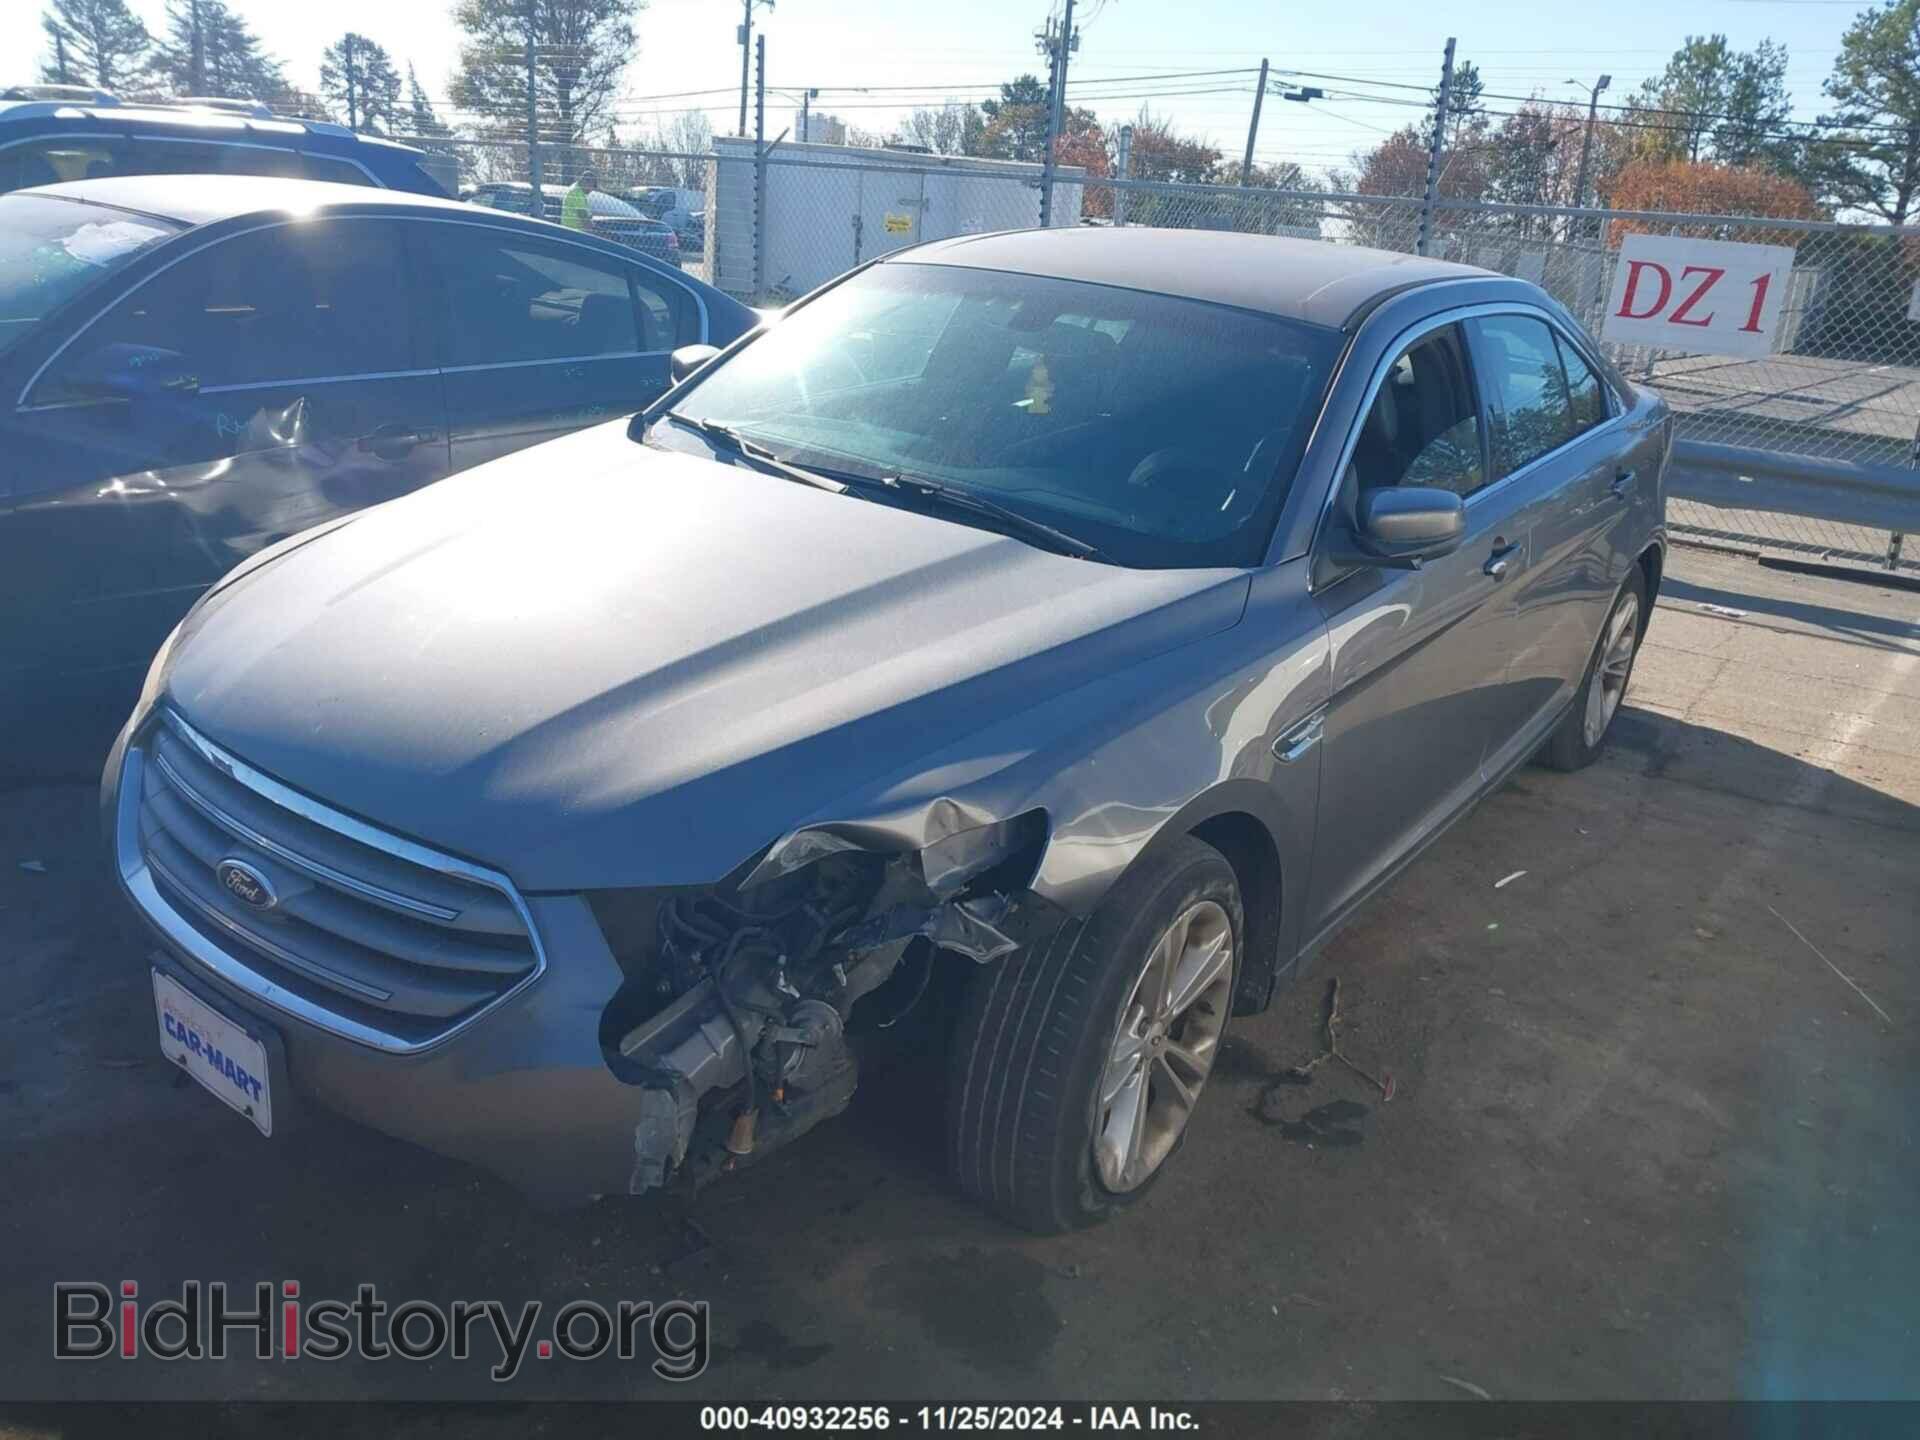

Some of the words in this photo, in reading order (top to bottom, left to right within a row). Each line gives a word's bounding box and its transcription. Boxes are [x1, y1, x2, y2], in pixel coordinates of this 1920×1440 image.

[1615, 260, 1726, 327] DZ
[1738, 272, 1772, 333] 1
[225, 867, 260, 902] Ford
[164, 1011, 262, 1103] CAR-MART
